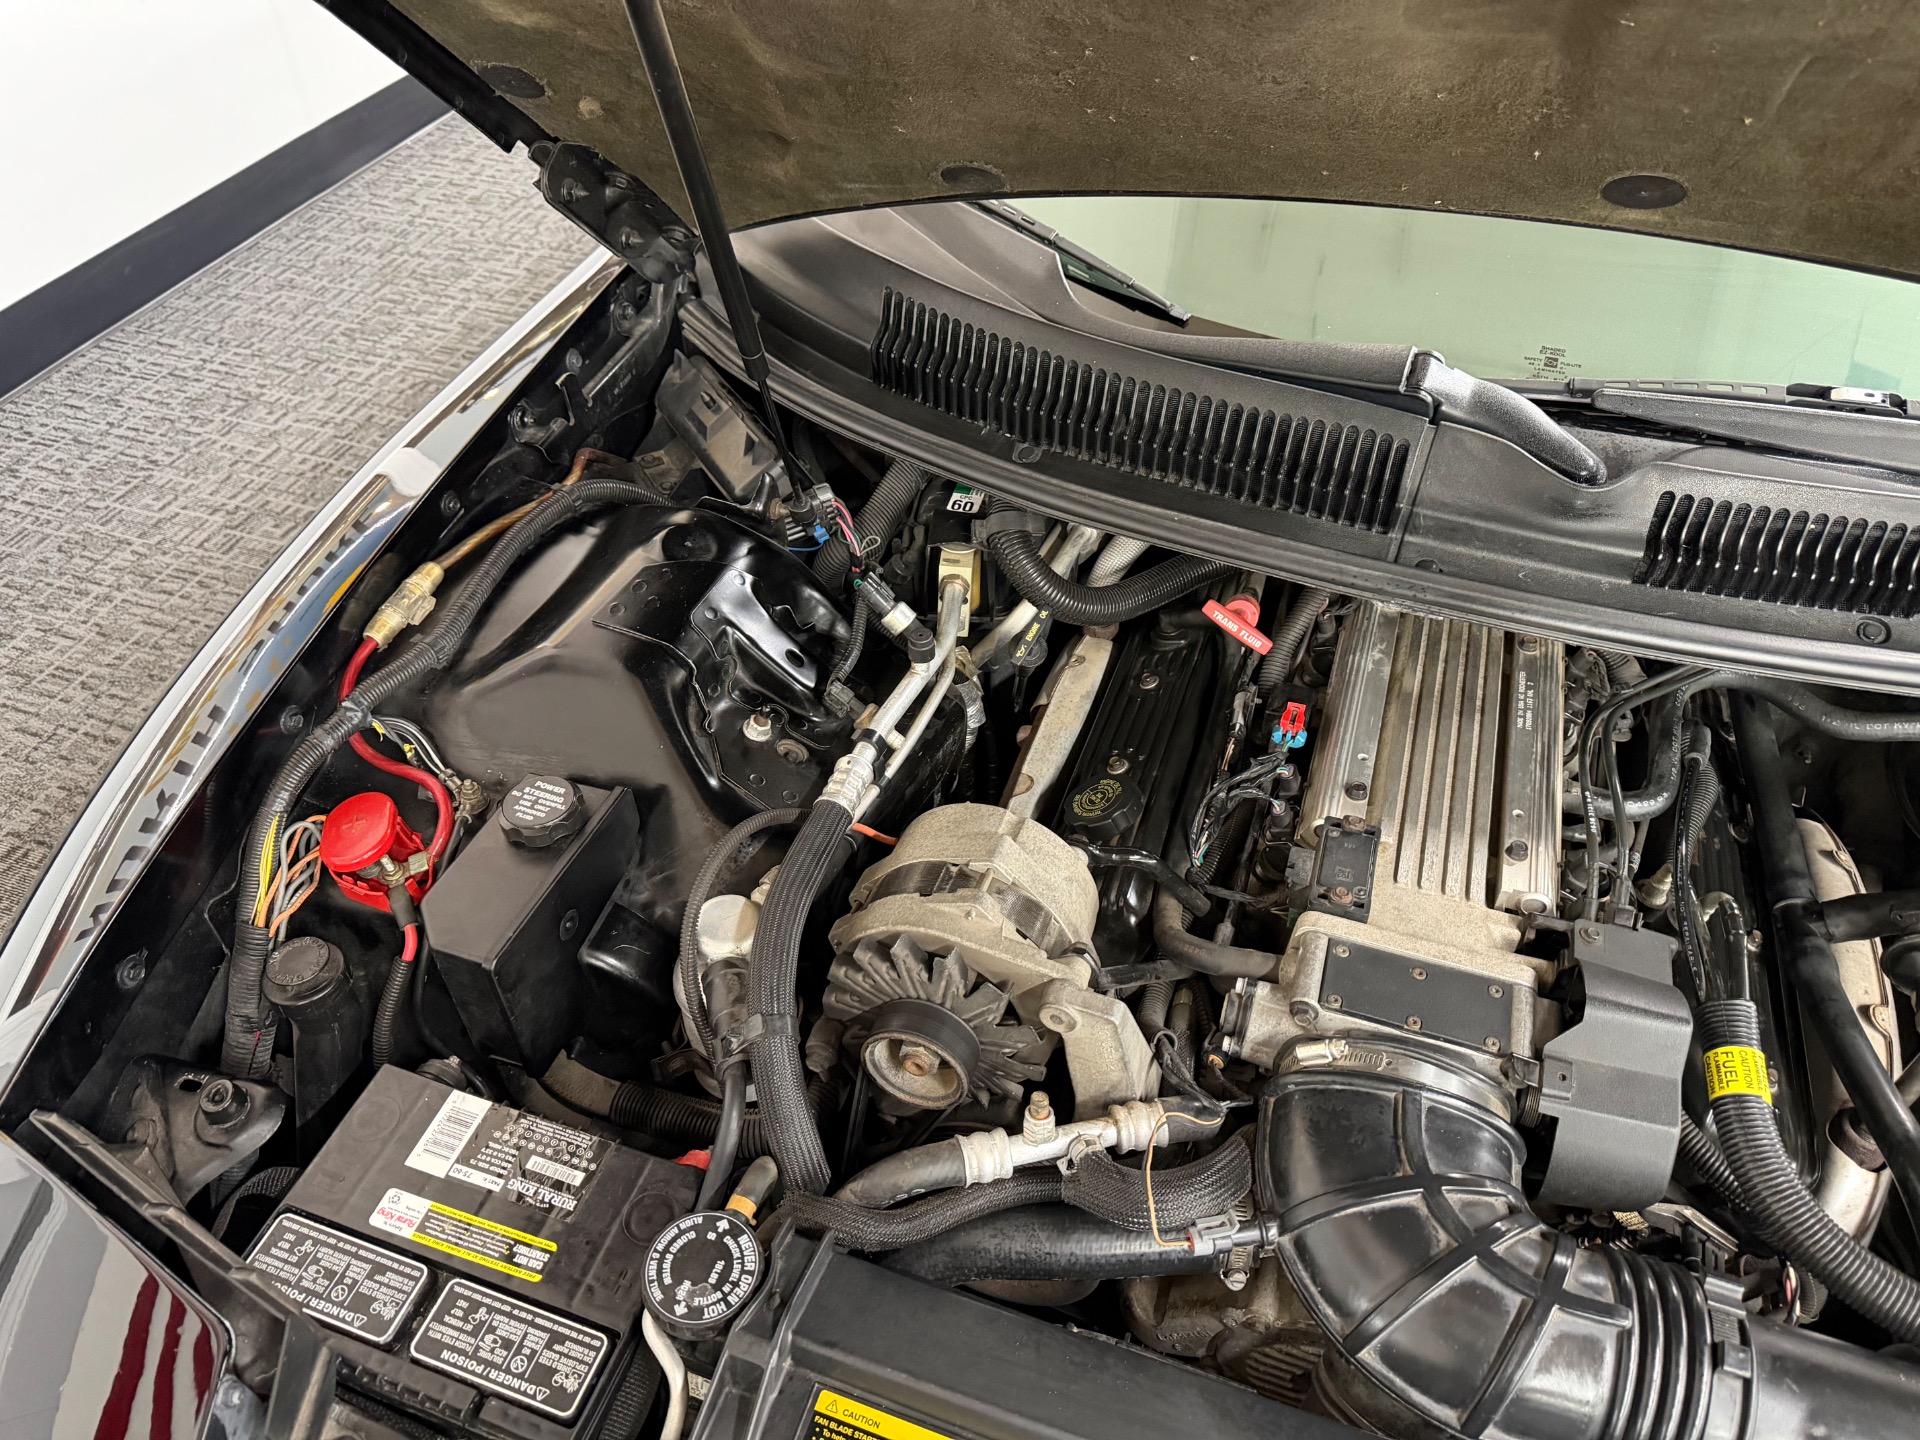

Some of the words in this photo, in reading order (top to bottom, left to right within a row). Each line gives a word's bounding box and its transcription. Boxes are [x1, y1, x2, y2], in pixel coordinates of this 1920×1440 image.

[1539, 349, 1566, 358] EZ-KOOL
[1541, 345, 1566, 354] SHADED
[1533, 367, 1566, 375] LAMINATED
[951, 499, 974, 512] 60
[1025, 621, 1041, 642] ENGINE
[1039, 610, 1049, 619] OIL
[1212, 610, 1239, 632] TRANS
[1239, 629, 1263, 648] FLUID
[534, 780, 566, 795] POWER
[523, 786, 565, 804] STEERING
[518, 799, 533, 807] USE
[534, 804, 551, 812] ONLY
[522, 794, 537, 802] NOT
[538, 798, 566, 810] OVERFILL
[513, 804, 547, 818] APPROVED
[515, 812, 534, 821] FLUID
[1705, 1055, 1716, 1095] CAUTION
[1713, 1051, 1726, 1091] FLAMMABLE
[1721, 1051, 1739, 1088] FUEL
[1738, 1049, 1754, 1089] CAUTION
[452, 1167, 473, 1178] 75-60
[489, 1165, 507, 1175] GROUP
[487, 1178, 500, 1186] PART
[506, 1178, 536, 1196] KING
[537, 1188, 576, 1210] RURAL
[376, 1206, 396, 1220] King
[388, 1222, 402, 1231] Return
[394, 1215, 416, 1228] Rural
[679, 1215, 704, 1230] ALIGN
[283, 1232, 296, 1241] FAST
[656, 1228, 679, 1252] ARROW
[669, 1230, 697, 1254] CLOSED
[277, 1240, 290, 1249] HELP
[445, 1244, 461, 1253] RURAL
[723, 1235, 742, 1259] CHECK
[269, 1247, 289, 1259] MEDICAL
[287, 1254, 298, 1262] GET
[512, 1244, 549, 1261] STARTING?
[651, 1252, 661, 1260] &
[737, 1234, 756, 1271] NEVER
[253, 1260, 267, 1270] WITH
[255, 1253, 284, 1268] IMMEDIATELY
[349, 1258, 369, 1269] SMOKING
[478, 1256, 499, 1266] TESTING
[512, 1253, 529, 1265] NOT
[527, 1258, 543, 1269] CAR
[266, 1265, 280, 1275] EYES
[283, 1264, 299, 1274] WATER
[345, 1269, 362, 1280] SPARKS
[348, 1264, 365, 1275] FLAMES
[499, 1264, 522, 1274] BATTERY
[648, 1259, 659, 1280] VENT
[662, 1253, 674, 1286] SYSTEM
[729, 1259, 742, 1282] LEVEL
[278, 1270, 295, 1281] FLUSH
[316, 1277, 329, 1286] ACID
[343, 1276, 352, 1284] NO
[299, 1278, 325, 1293] SULFURIC
[358, 1285, 372, 1295] EYES
[362, 1278, 379, 1290] GASES
[721, 1282, 733, 1294] IN
[726, 1274, 753, 1306] OPEN
[371, 1290, 390, 1301] SHIELD
[378, 1285, 406, 1300] EXPLOSIVE
[650, 1281, 664, 1302] TUBE
[455, 1298, 469, 1308] FAST
[693, 1290, 724, 1306] BOTTLE
[450, 1307, 463, 1317] HELP
[702, 1301, 728, 1319] HOT
[443, 1314, 463, 1327] MEDICAL
[492, 1313, 509, 1323] INJURY
[508, 1319, 525, 1329] SEVERE
[428, 1321, 459, 1337] IMMEDIATELY
[462, 1322, 473, 1331] GET
[495, 1327, 509, 1338] CAUSE
[526, 1326, 547, 1338] SMOKING
[427, 1329, 442, 1339] WITH
[441, 1334, 455, 1345] EYES
[458, 1332, 475, 1344] WATER
[508, 1333, 518, 1341] CAN
[525, 1333, 543, 1344] FLAMES
[454, 1339, 471, 1351] FLUSH
[521, 1346, 531, 1355] NO
[522, 1339, 540, 1350] SPARKS
[552, 1343, 569, 1353] INJURY
[564, 1340, 589, 1354] BLINDNESS
[476, 1348, 503, 1364] SULFURIC
[493, 1347, 507, 1357] ACID
[541, 1348, 559, 1361] GASES
[568, 1349, 583, 1359] CAUSE
[538, 1355, 552, 1366] EYES
[558, 1355, 588, 1372] EXPLOSIVE
[582, 1355, 593, 1363] CAN
[440, 1349, 535, 1394] DANGER/POISON
[551, 1361, 571, 1373] SHIELD
[842, 1408, 881, 1429] CAUTION
[814, 1415, 829, 1427] FAN
[829, 1421, 854, 1436] BLADE
[822, 1428, 831, 1438] To
